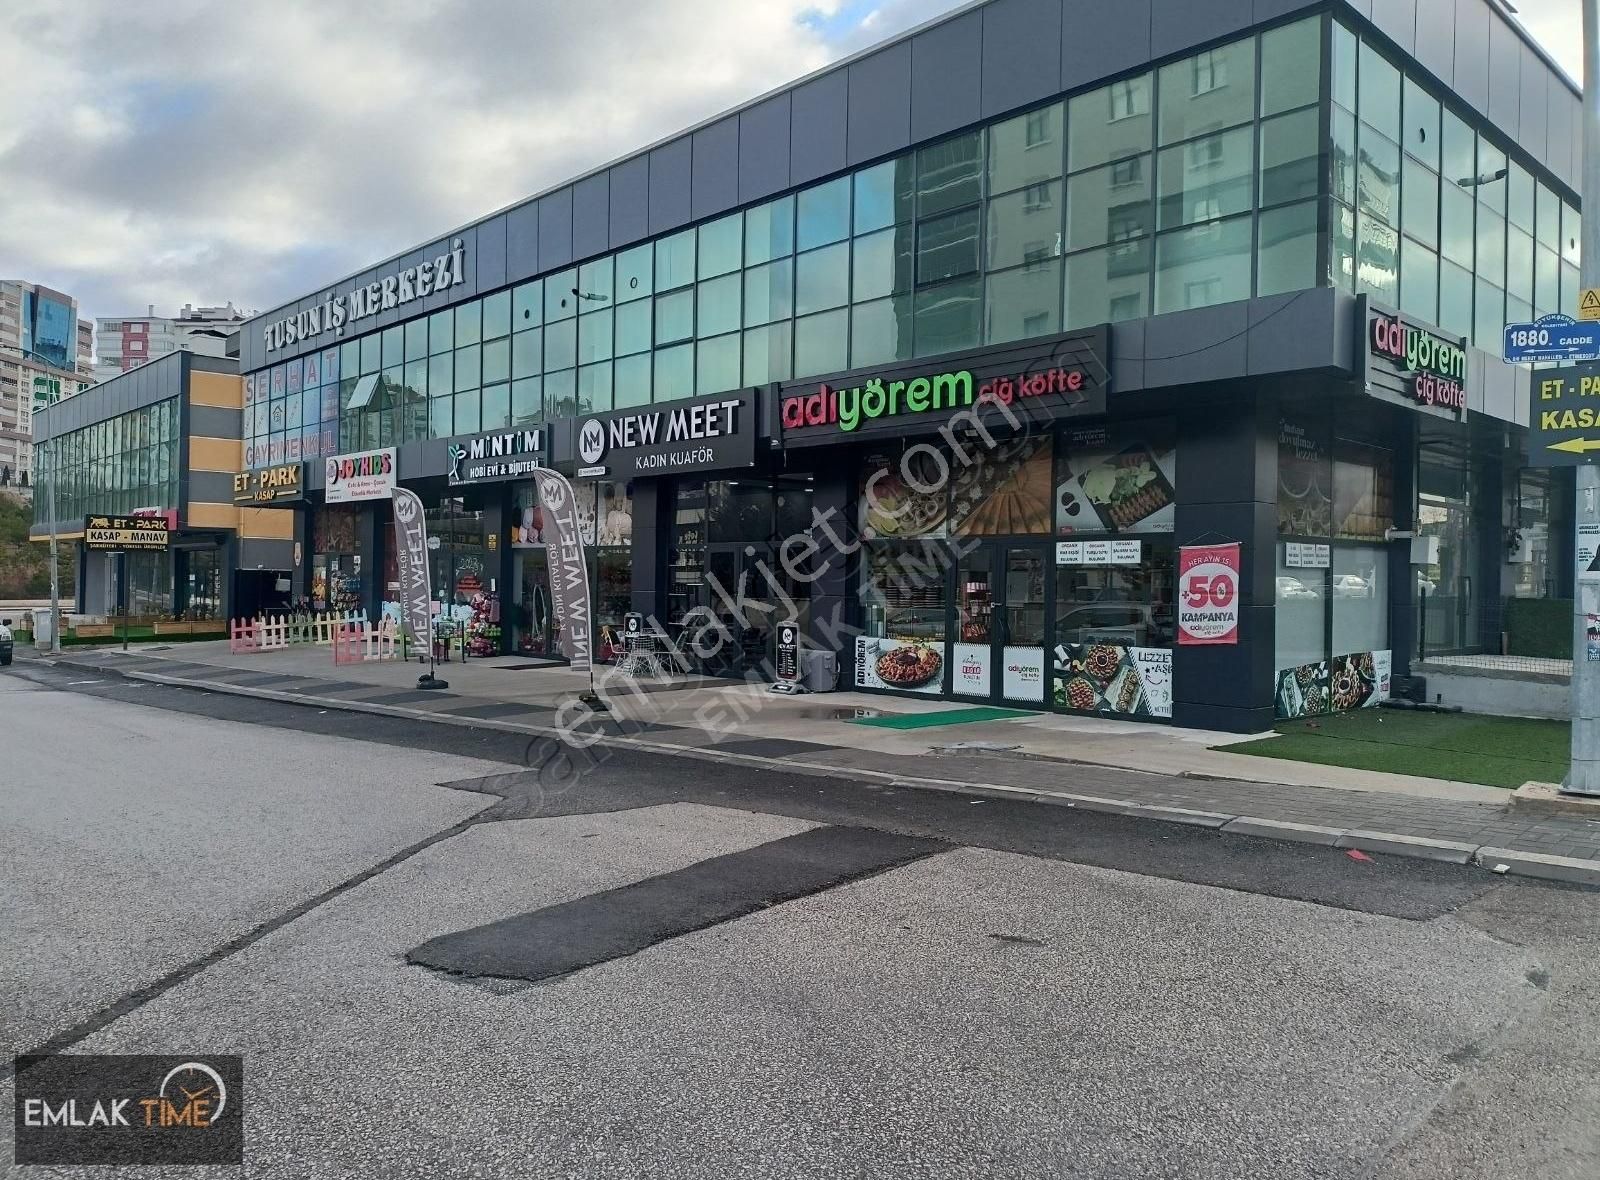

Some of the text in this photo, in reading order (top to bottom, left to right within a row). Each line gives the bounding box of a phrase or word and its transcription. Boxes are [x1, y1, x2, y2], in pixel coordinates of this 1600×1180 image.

[265, 238, 464, 351] TUSUN İŞ MERKEZİ
[1376, 317, 1465, 379] adıyörem
[1559, 337, 1592, 345] CADDE
[246, 353, 336, 401] SERHAT
[782, 370, 972, 431] adıyörem
[1019, 368, 1083, 397] köfte
[1436, 377, 1465, 408] köfte
[1541, 379, 1564, 399] ET
[610, 399, 740, 449] NEW MEET
[635, 446, 714, 470] KADIN KUAFÖR
[234, 473, 250, 491] ET
[260, 466, 297, 488] PARK
[470, 464, 486, 478] HOBİ
[487, 462, 498, 476] EVİ
[254, 489, 275, 501] KASAP
[114, 519, 127, 528] ET
[136, 520, 167, 529] PARK
[90, 531, 120, 541] KASAP
[131, 532, 165, 541] MANAV
[1188, 558, 1203, 567] HER
[1203, 555, 1220, 563] AYIN
[1182, 612, 1234, 622] KAMPANYA
